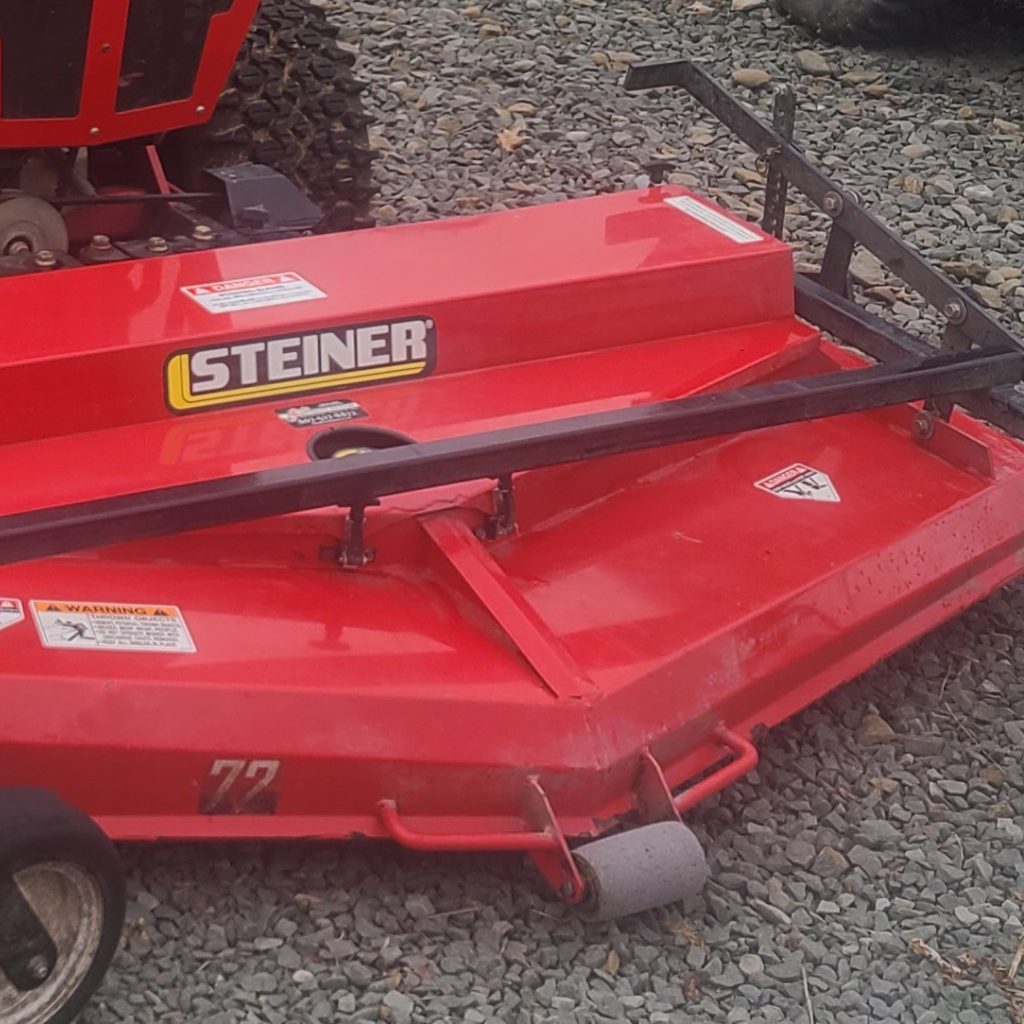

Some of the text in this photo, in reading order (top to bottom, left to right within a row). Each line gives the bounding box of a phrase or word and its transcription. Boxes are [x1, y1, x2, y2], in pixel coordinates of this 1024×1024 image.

[211, 277, 276, 292] DANGER
[191, 320, 428, 393] STEINER
[65, 604, 147, 616] WARNING
[206, 759, 280, 814] 72
